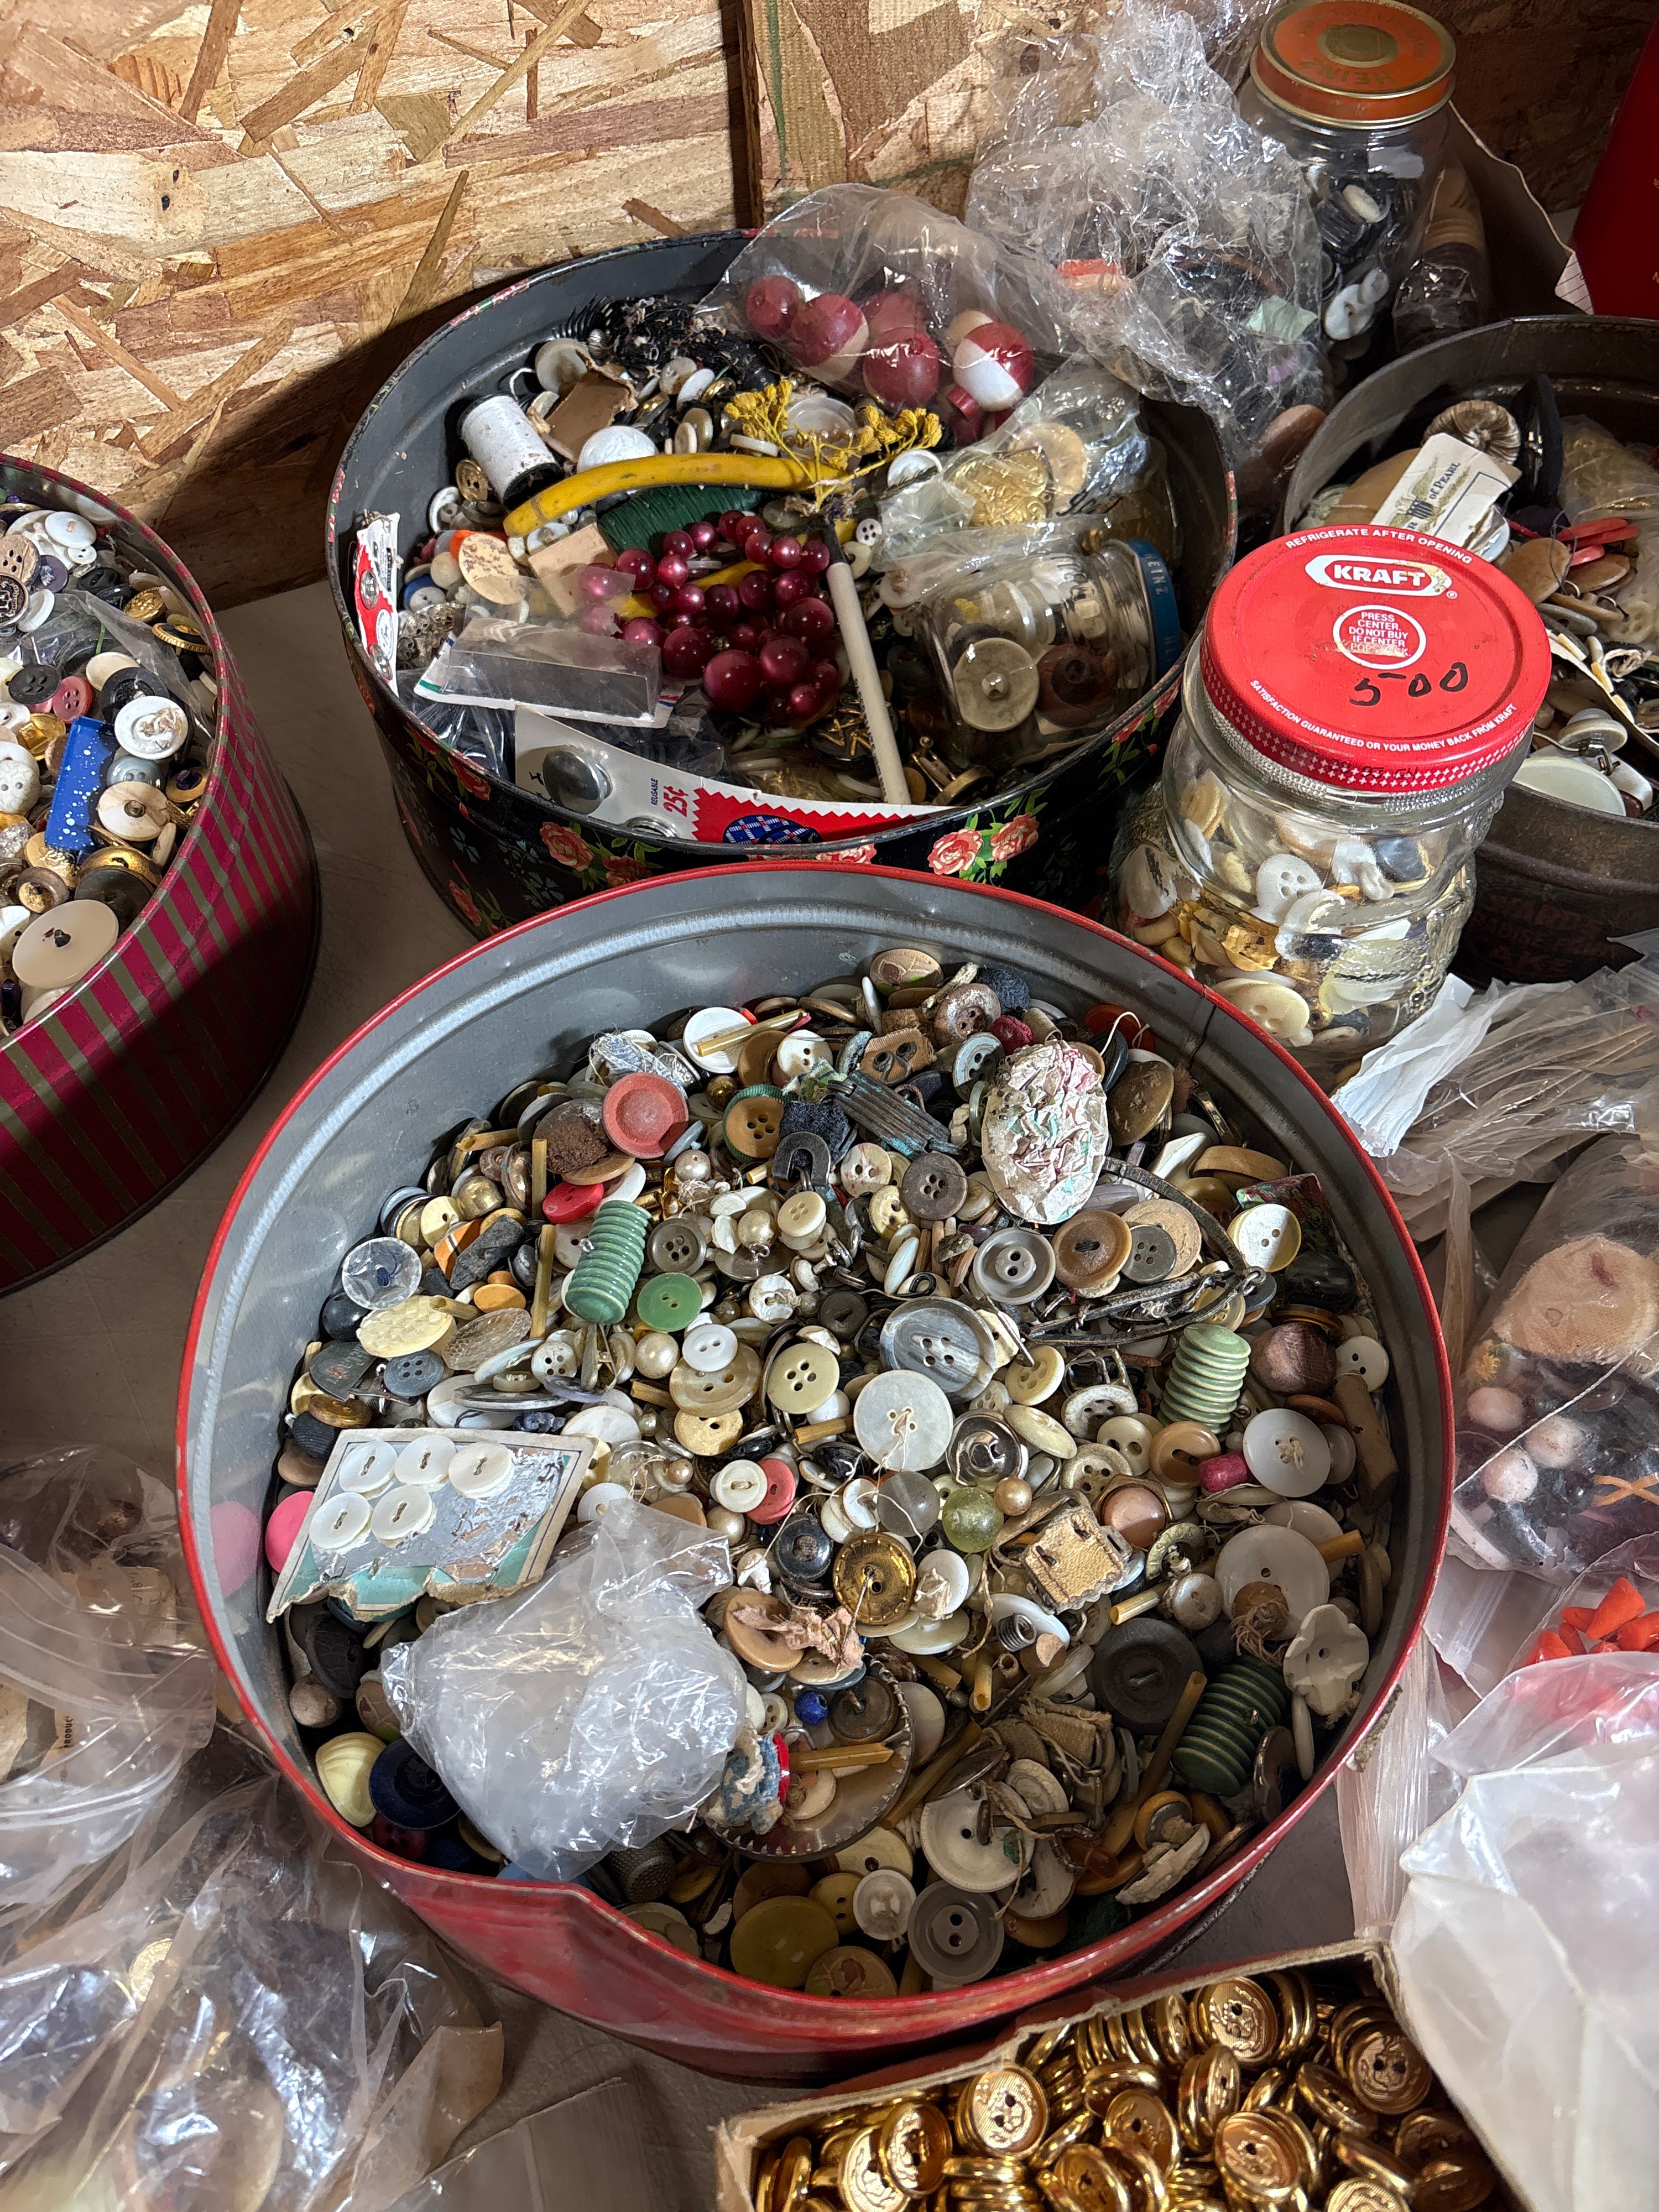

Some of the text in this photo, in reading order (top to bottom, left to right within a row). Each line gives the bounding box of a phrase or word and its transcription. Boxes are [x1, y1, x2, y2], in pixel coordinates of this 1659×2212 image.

[1300, 58, 1395, 85] HEINZ
[1429, 462, 1461, 500] of PEARL
[1285, 528, 1473, 565] REFRIGERATE AFTER OPENING
[1144, 554, 1168, 596] HEINZ
[1333, 564, 1426, 587] KRAFT
[1357, 619, 1402, 631] CENTER.
[1361, 612, 1395, 622] PRESS
[1348, 626, 1408, 640] DO NOT BUY
[1363, 636, 1405, 648] CENTER
[1250, 680, 1517, 752] SATISFACTION GUARANTEED OR YOUR MONEY BACK FROM KRAFT
[650, 778, 659, 806] REUSABLE
[663, 786, 688, 817] 25¢
